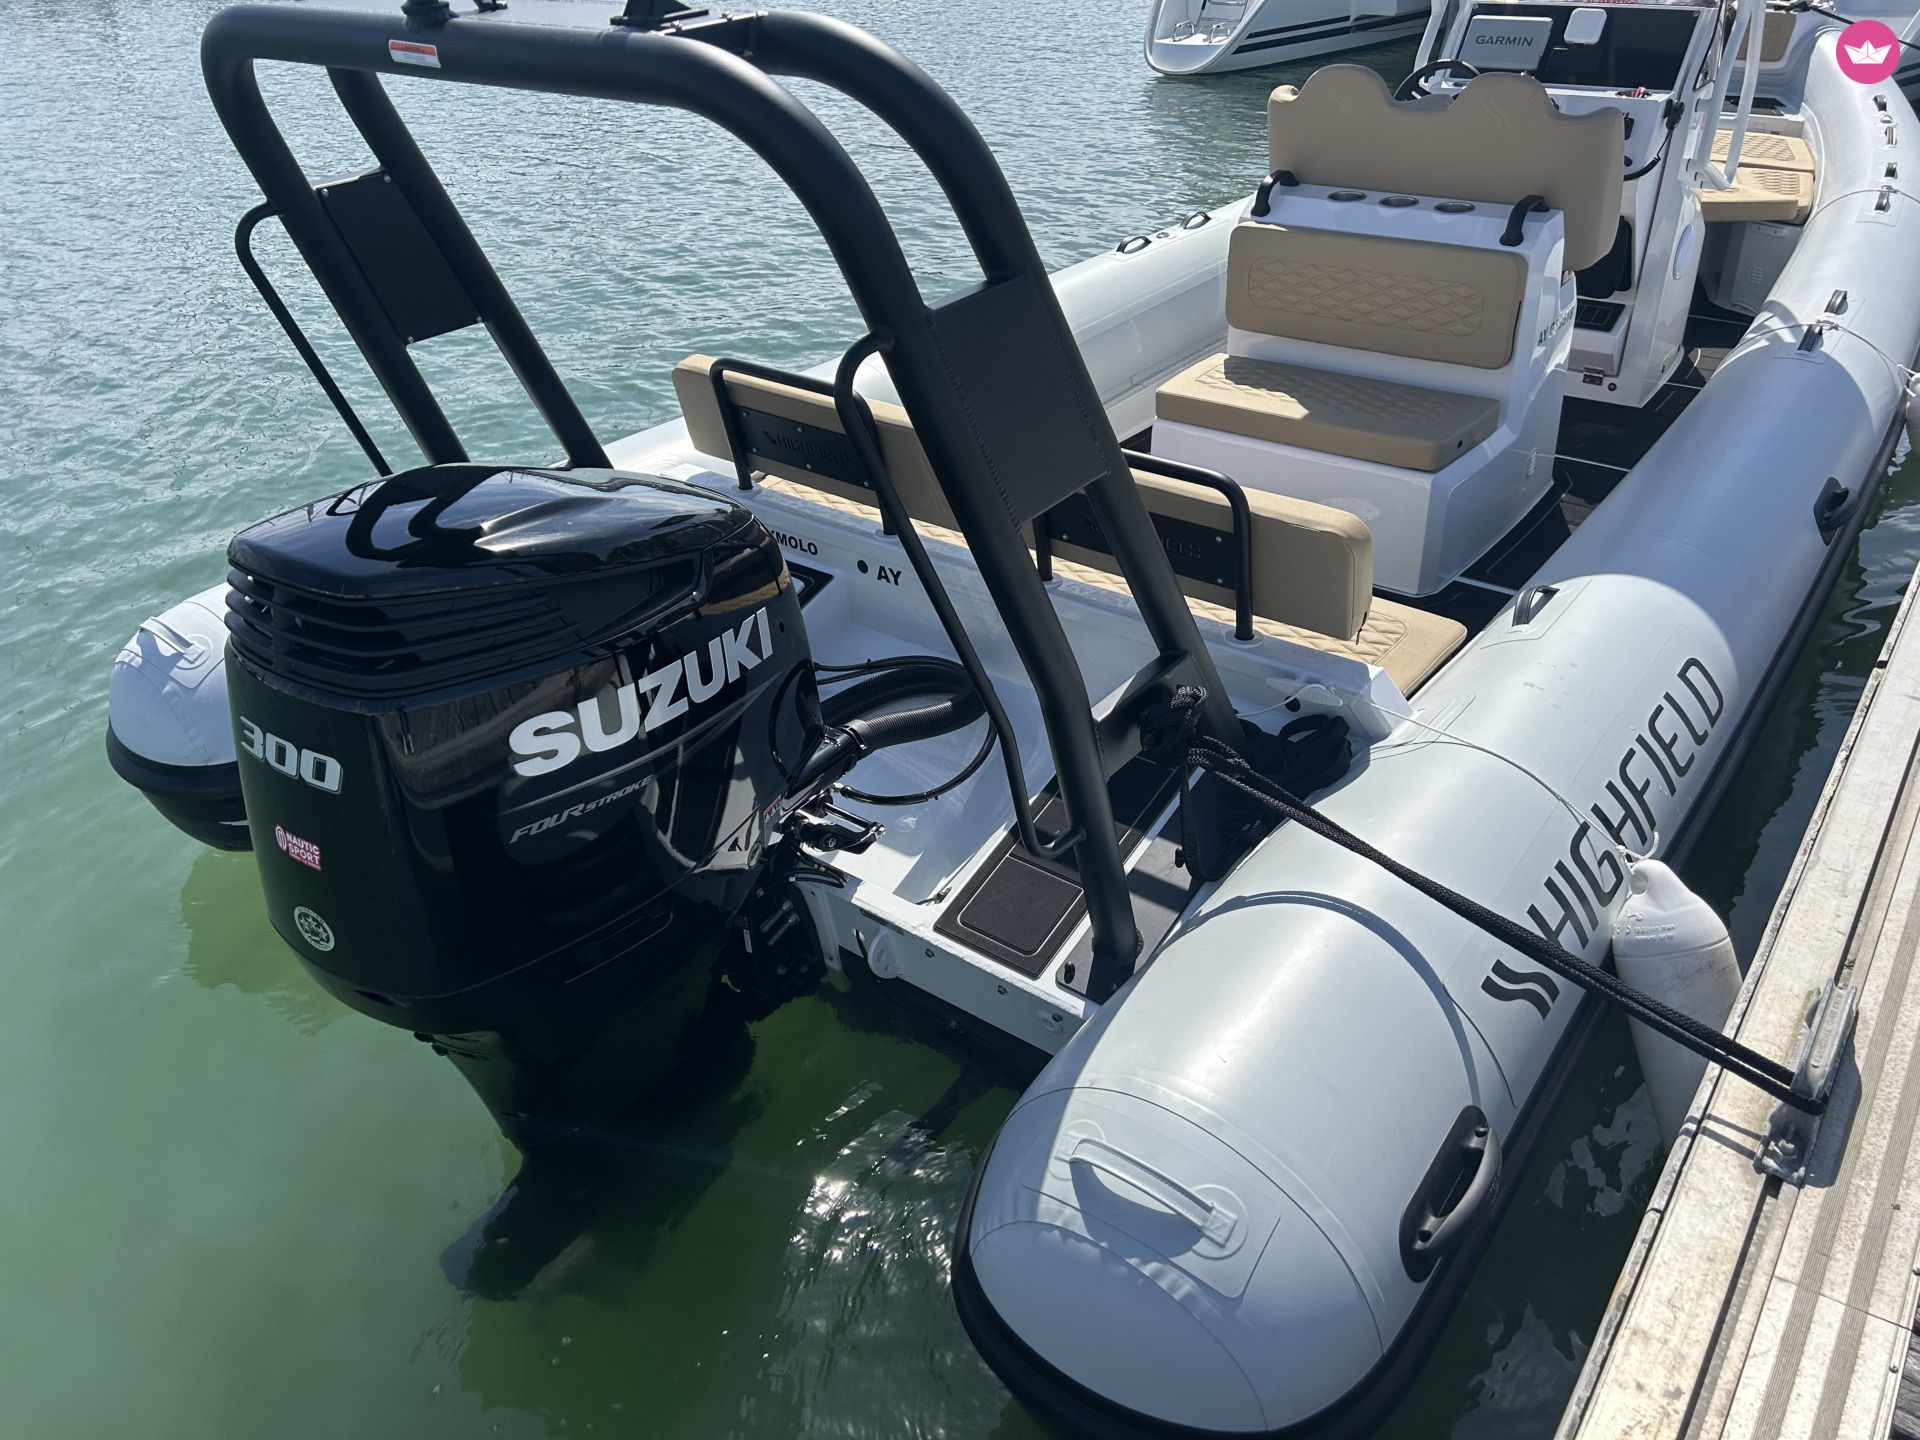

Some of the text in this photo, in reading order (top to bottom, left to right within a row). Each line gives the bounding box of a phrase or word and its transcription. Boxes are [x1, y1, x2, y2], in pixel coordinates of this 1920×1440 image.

[1475, 35, 1534, 47] GARMIN
[771, 530, 818, 556] MOLO
[876, 565, 902, 586] AY
[509, 606, 773, 777] SUZUKI
[239, 715, 343, 794] 300
[1526, 657, 1724, 950] HIGHFIELD
[286, 832, 320, 855] NAUTIC
[288, 842, 321, 865] SPORT
